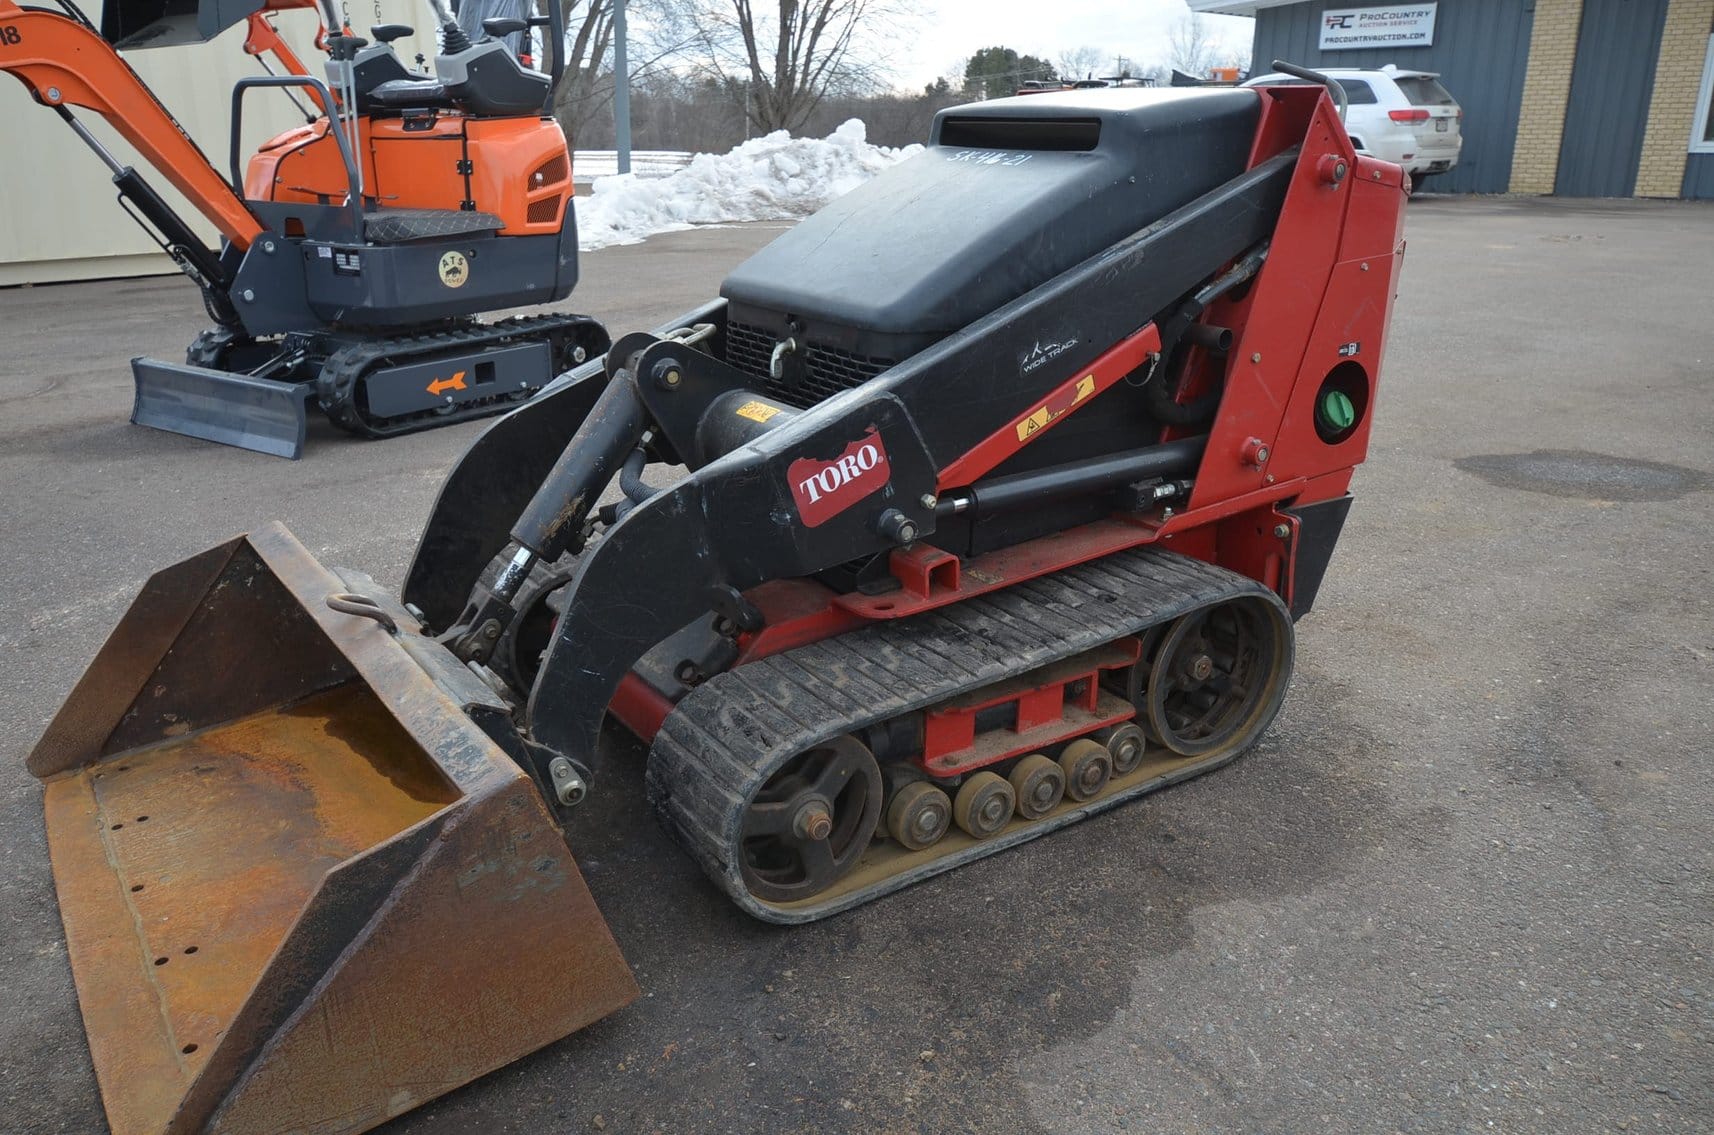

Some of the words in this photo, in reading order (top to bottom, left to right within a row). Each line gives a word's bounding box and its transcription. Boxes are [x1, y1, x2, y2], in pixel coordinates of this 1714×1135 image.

[442, 256, 464, 268] ATS
[1023, 355, 1047, 373] WIDE
[1047, 338, 1079, 358] TRACK
[799, 444, 878, 505] TORO
